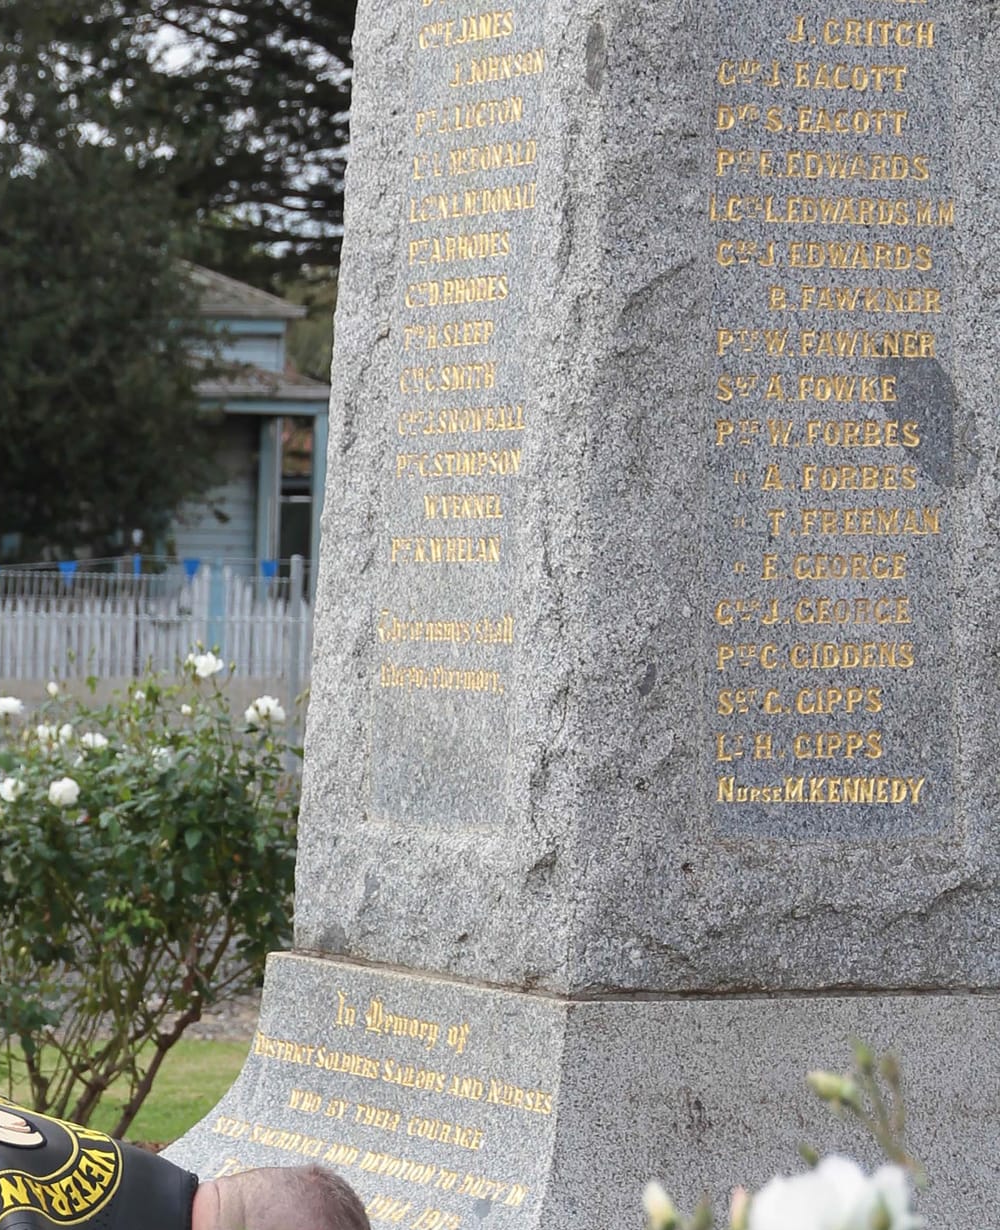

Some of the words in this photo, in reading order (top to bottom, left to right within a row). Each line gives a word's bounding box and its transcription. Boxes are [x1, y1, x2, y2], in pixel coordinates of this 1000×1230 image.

[456, 10, 514, 43] JAMES
[823, 19, 935, 48] CRITCH
[467, 48, 545, 85] JOHNSON
[795, 60, 908, 92] EACOTT
[797, 107, 908, 137] EACOTT
[785, 150, 930, 181] EDWARDS
[445, 229, 511, 263] RHODES
[789, 241, 933, 270] EDWARDS
[443, 273, 510, 305] RHODES
[799, 284, 942, 313] FAWKNER
[442, 319, 494, 348] SLEEP
[799, 330, 937, 358] FAWKNER
[441, 361, 497, 391] SMITH
[799, 374, 898, 402] FOWKE
[437, 404, 526, 434] SNOWBALL
[805, 420, 921, 448] FORBES
[433, 447, 522, 478] STIMPSON
[801, 463, 918, 491] FORBES
[800, 507, 941, 536] FREEMAN
[430, 535, 502, 563] WHELAN
[335, 990, 356, 1028] In
[447, 1021, 470, 1055] of
[447, 1074, 485, 1101] AND
[287, 1088, 322, 1113] WHO
[324, 1098, 350, 1120] BY
[354, 1103, 400, 1132] THEIR
[407, 1115, 484, 1151] COURAGE
[322, 1142, 361, 1167] AND
[358, 1150, 437, 1185] DEVOTION
[433, 1168, 459, 1191] TO
